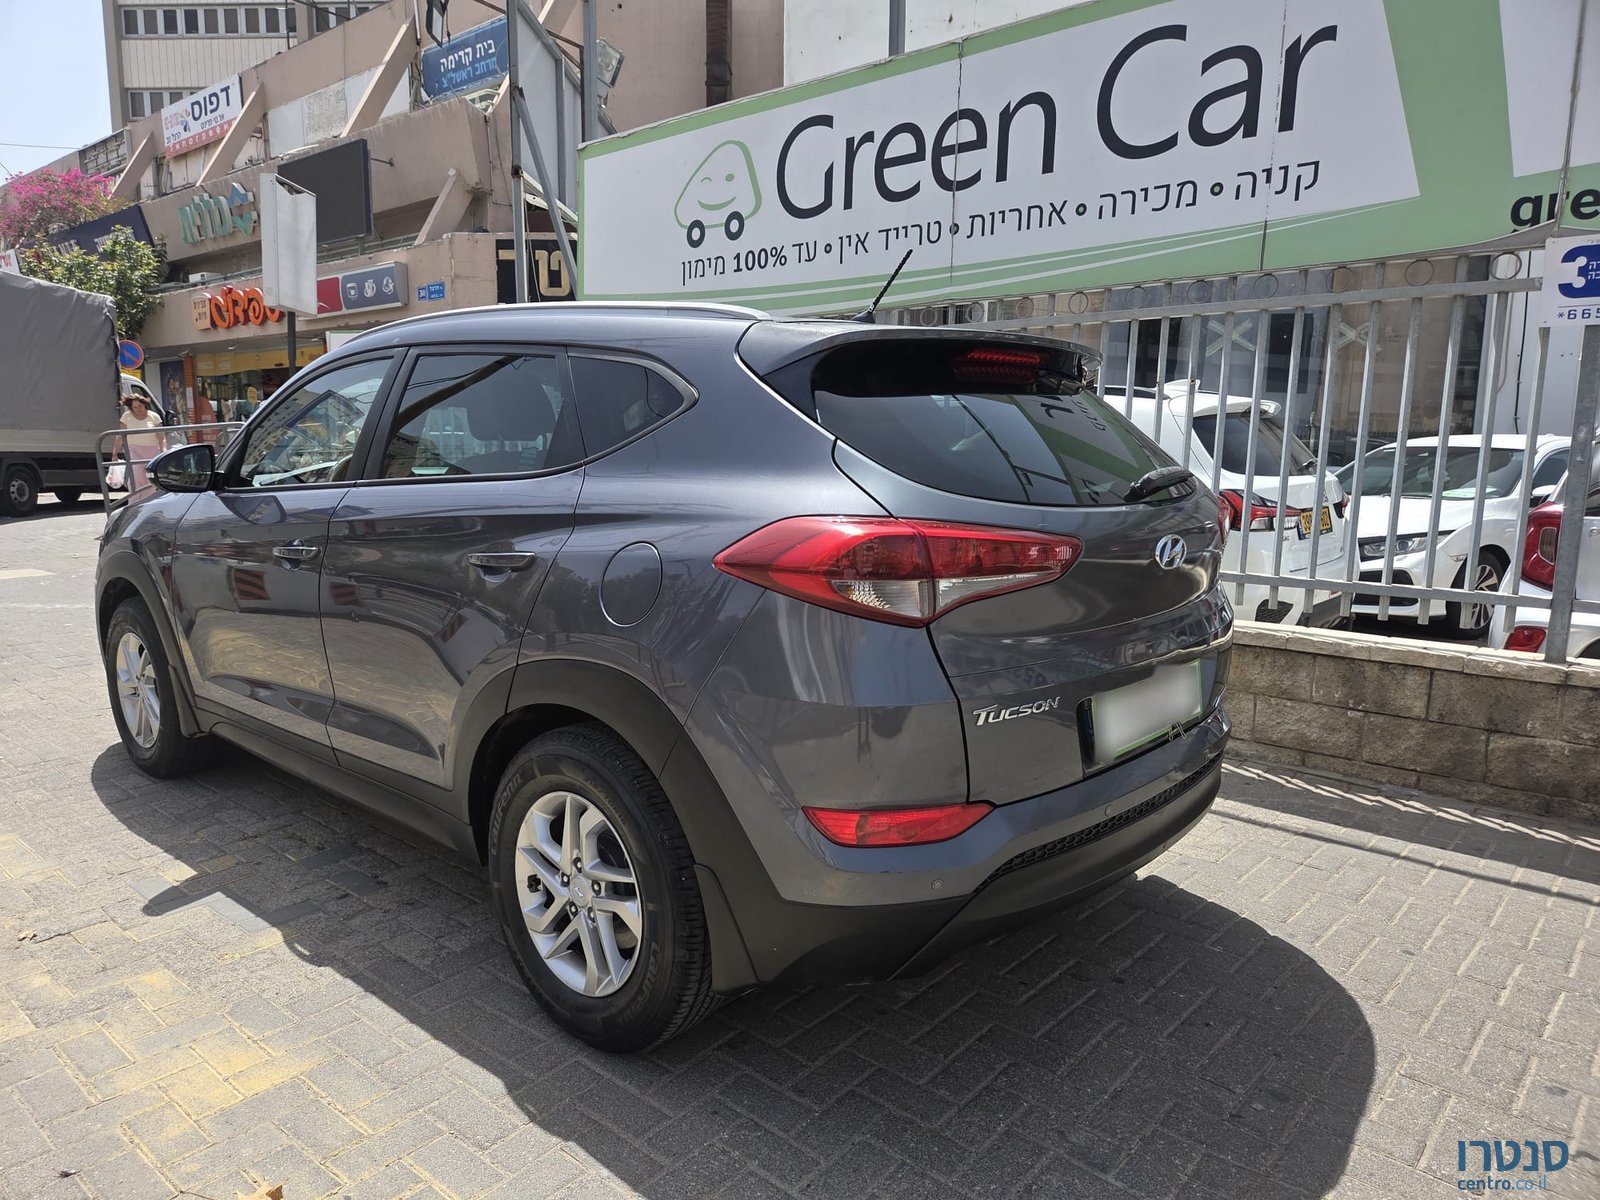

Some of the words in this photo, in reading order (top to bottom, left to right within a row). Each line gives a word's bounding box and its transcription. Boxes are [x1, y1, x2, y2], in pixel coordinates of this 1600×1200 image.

[476, 39, 496, 58] בית
[190, 85, 231, 122] דפוס
[776, 91, 1058, 220] Green
[1096, 24, 1338, 160] Car
[1234, 160, 1320, 202] קניה
[1098, 179, 1198, 220] מכירה
[966, 199, 1068, 239] אחריות
[838, 231, 870, 264] אין
[878, 220, 942, 251] טרייד
[733, 245, 787, 273] 100%
[792, 240, 818, 264] עד
[681, 255, 726, 286] מימון
[973, 696, 1060, 727] TUCSON
